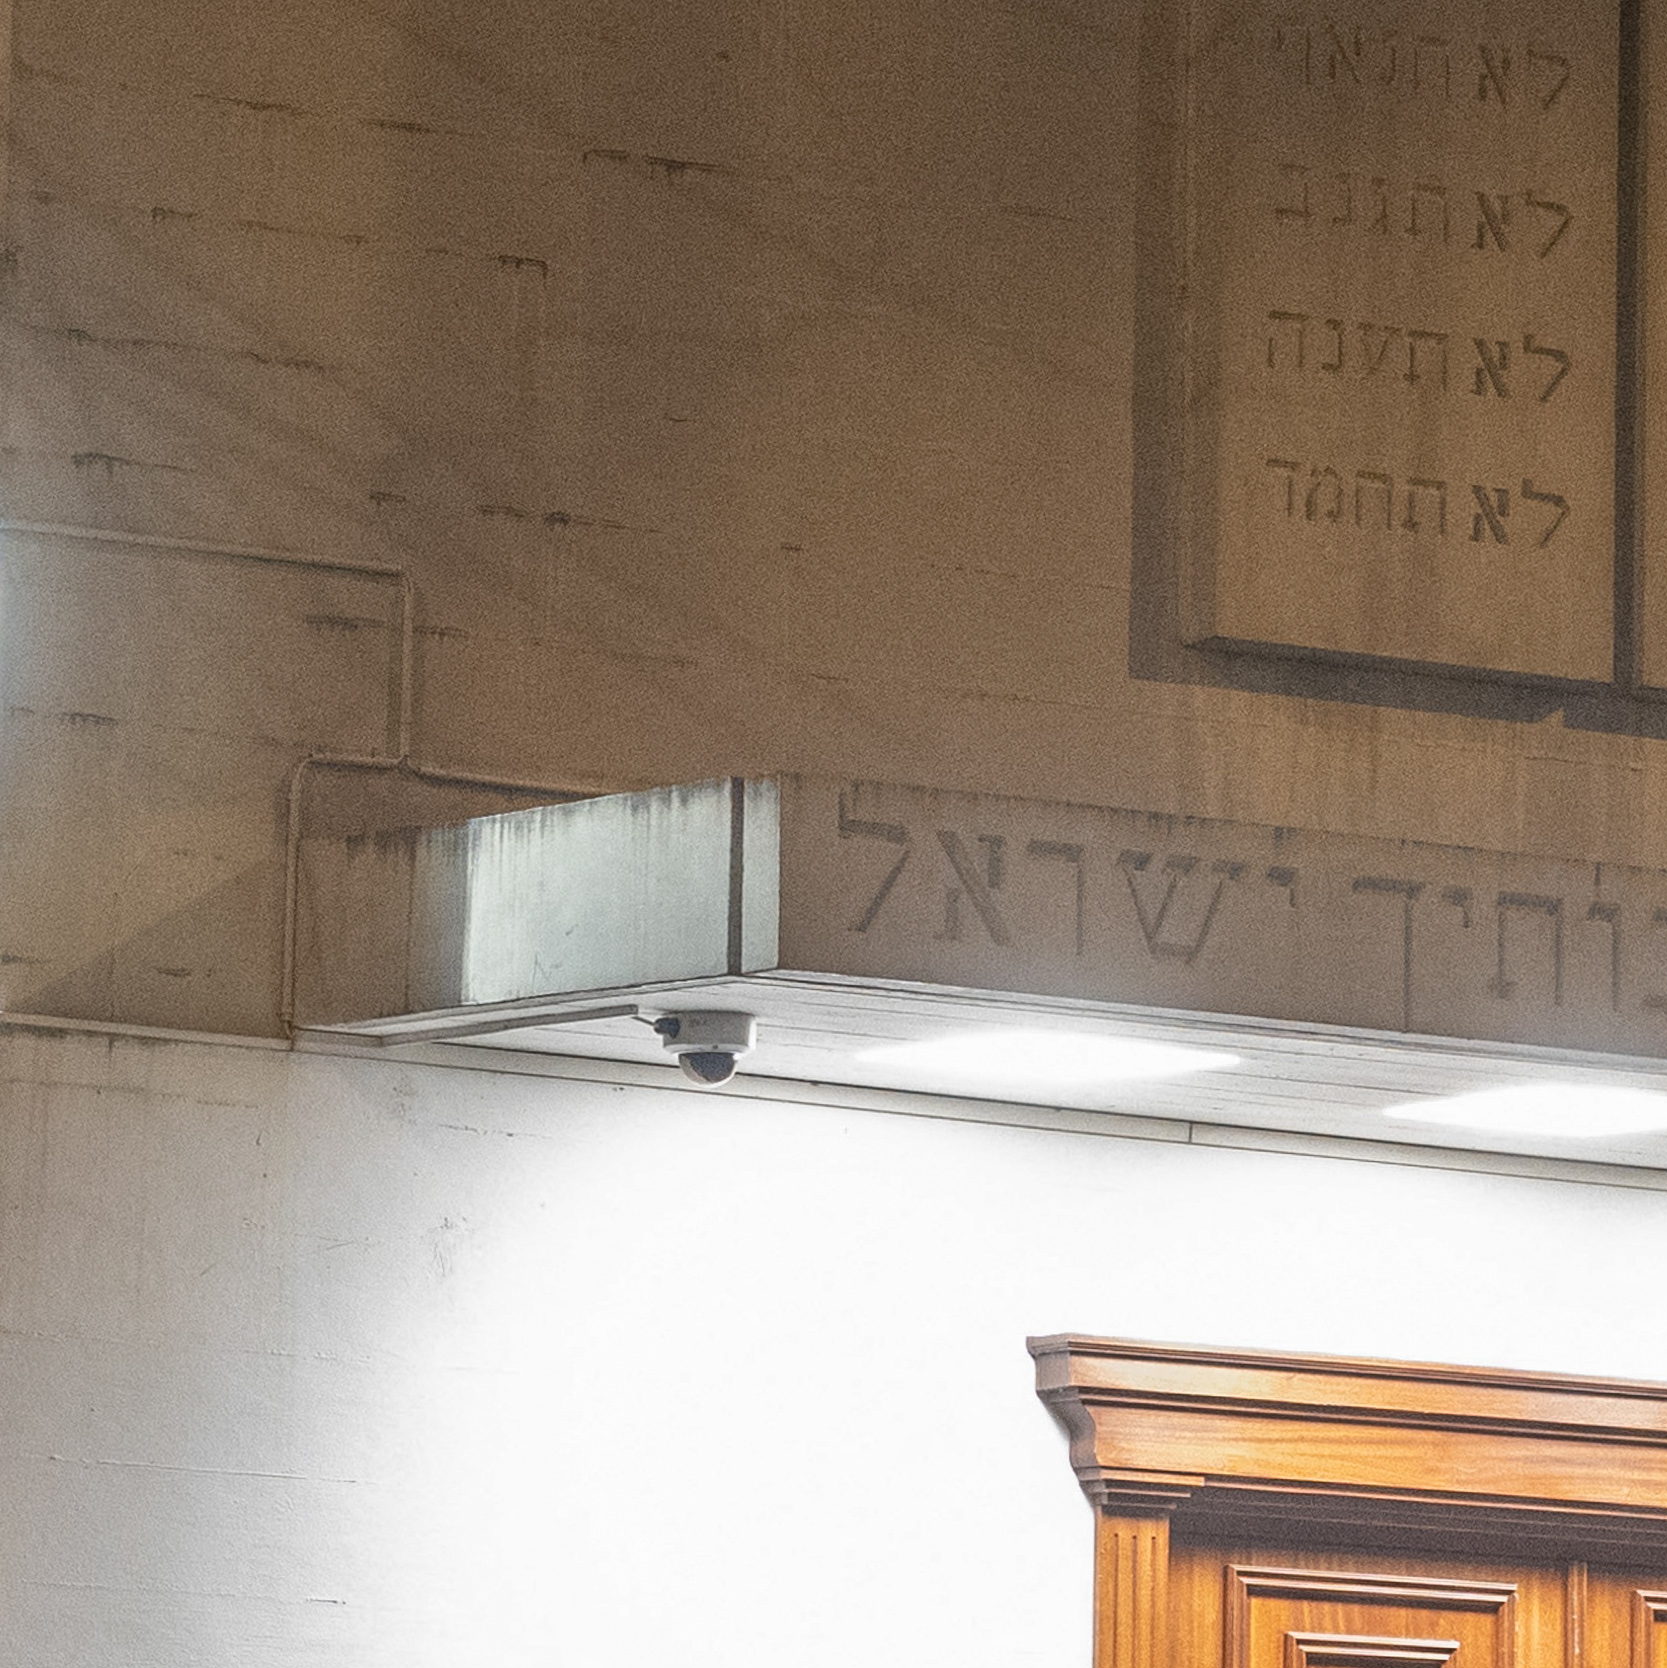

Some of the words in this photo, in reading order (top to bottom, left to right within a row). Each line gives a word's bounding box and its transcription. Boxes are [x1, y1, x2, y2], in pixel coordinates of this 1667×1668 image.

[1476, 40, 1571, 110] לא
[1273, 160, 1450, 246] תגנב
[1473, 188, 1573, 260] לא
[1266, 308, 1449, 392] תענה
[1472, 332, 1572, 404] לא
[1265, 456, 1448, 536] תחמד
[1470, 477, 1571, 548] לא
[838, 783, 1300, 966] ישראל
